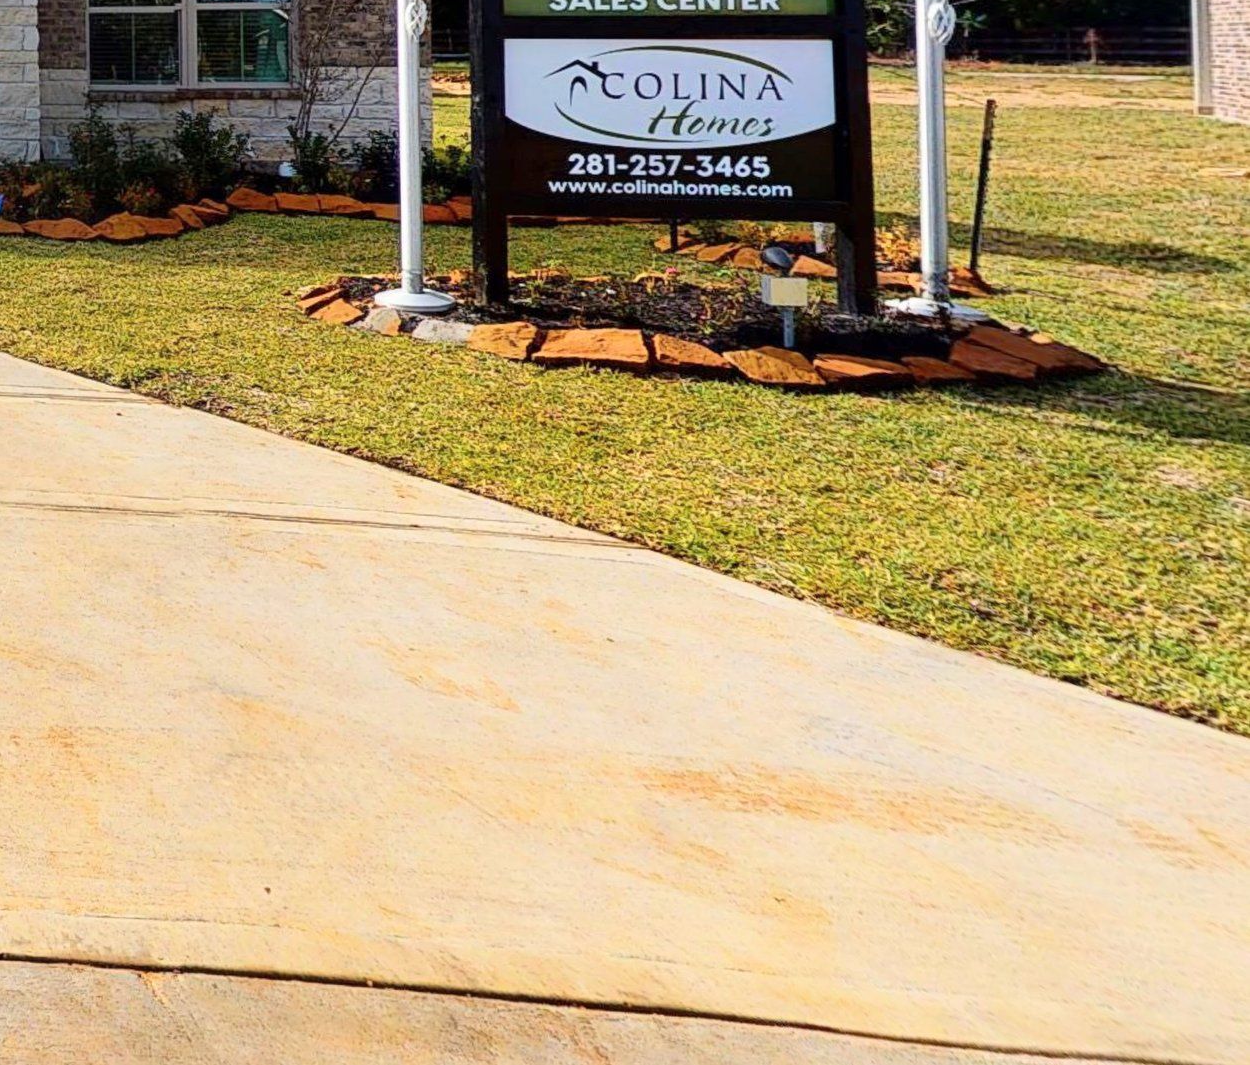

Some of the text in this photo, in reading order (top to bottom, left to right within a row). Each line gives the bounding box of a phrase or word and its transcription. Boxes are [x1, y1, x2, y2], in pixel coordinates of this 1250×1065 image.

[601, 72, 784, 101] COLINA
[648, 100, 773, 137] Homes
[568, 153, 771, 178] 281-257-3465
[548, 179, 793, 198] www.colinahomes.com
